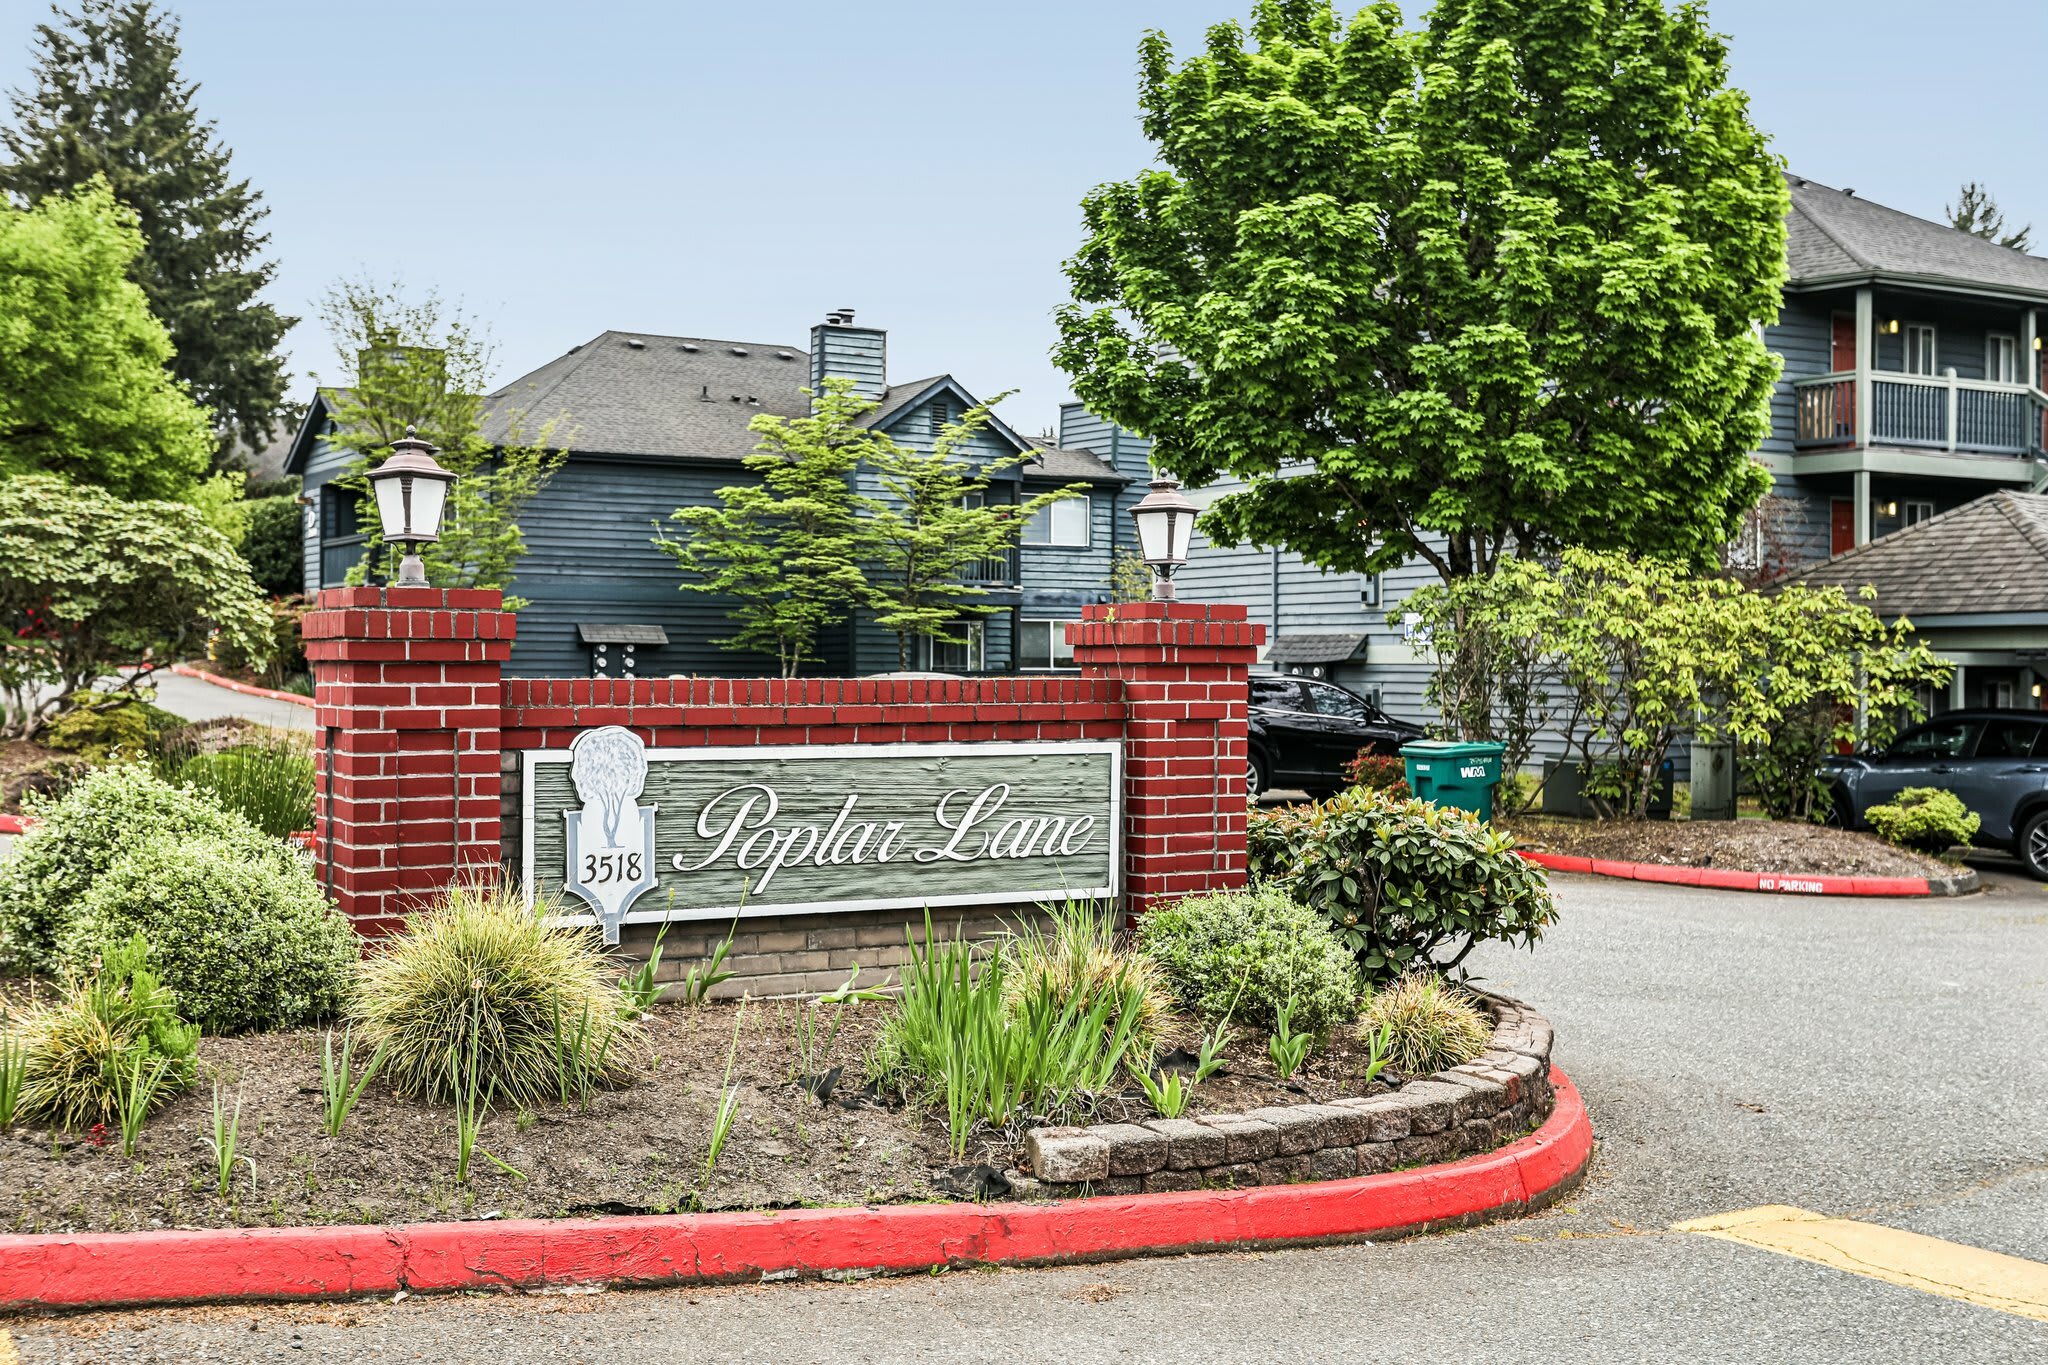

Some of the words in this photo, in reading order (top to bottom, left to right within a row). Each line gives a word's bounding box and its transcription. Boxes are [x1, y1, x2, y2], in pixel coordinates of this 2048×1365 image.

[1460, 765, 1486, 778] WM
[672, 783, 906, 895] Poplar
[913, 783, 1096, 862] Lane
[581, 852, 642, 884] 3518
[1759, 878, 1775, 890] NO
[1778, 879, 1824, 893] PARKING
